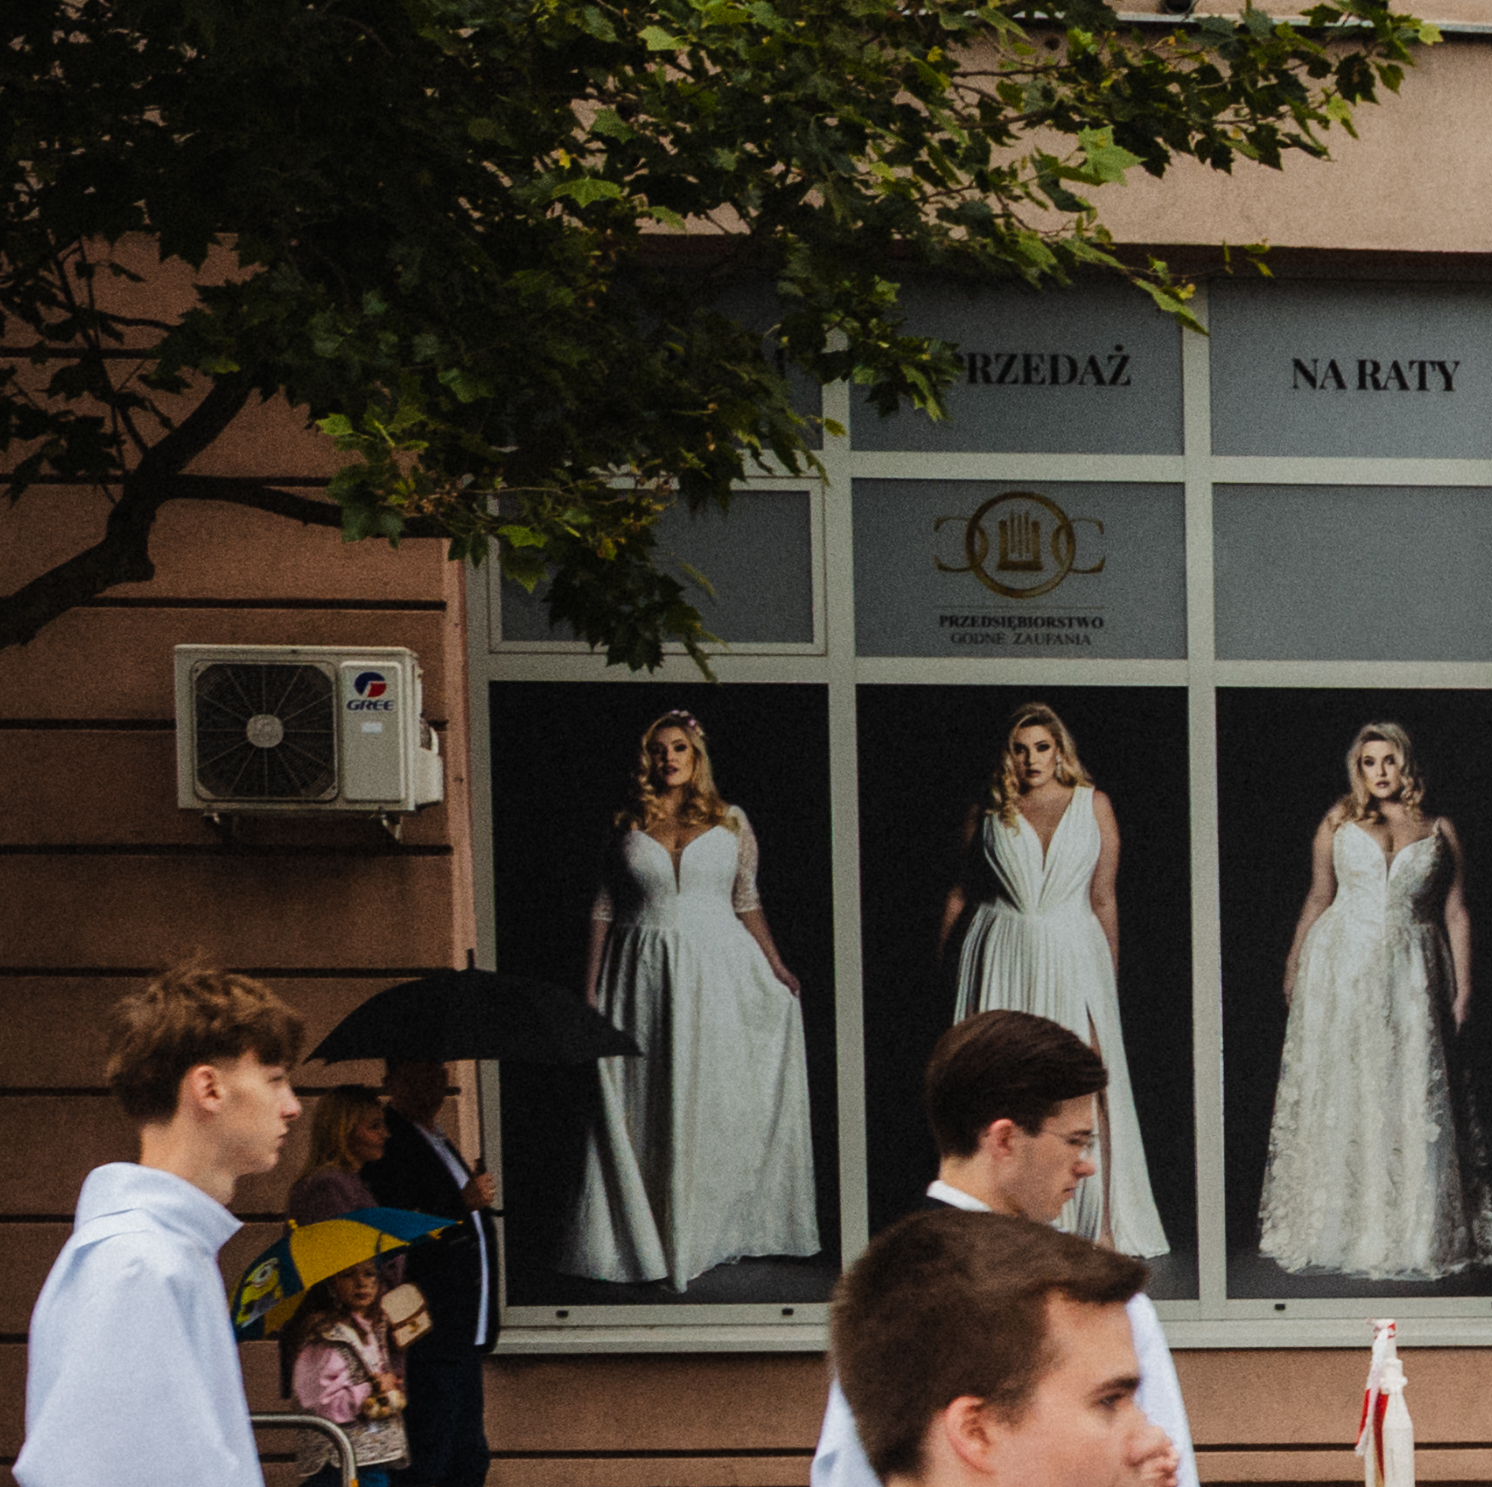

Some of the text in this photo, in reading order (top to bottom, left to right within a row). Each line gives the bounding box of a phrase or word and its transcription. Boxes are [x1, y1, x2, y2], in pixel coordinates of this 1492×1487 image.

[957, 344, 1132, 386] RZEDAŻ
[1291, 357, 1461, 392] NA RATY
[938, 614, 1105, 631] PRZEDSIĘBIORSTWO
[950, 632, 1092, 646] GODNE ZAUFANIA
[346, 699, 395, 711] GREE
